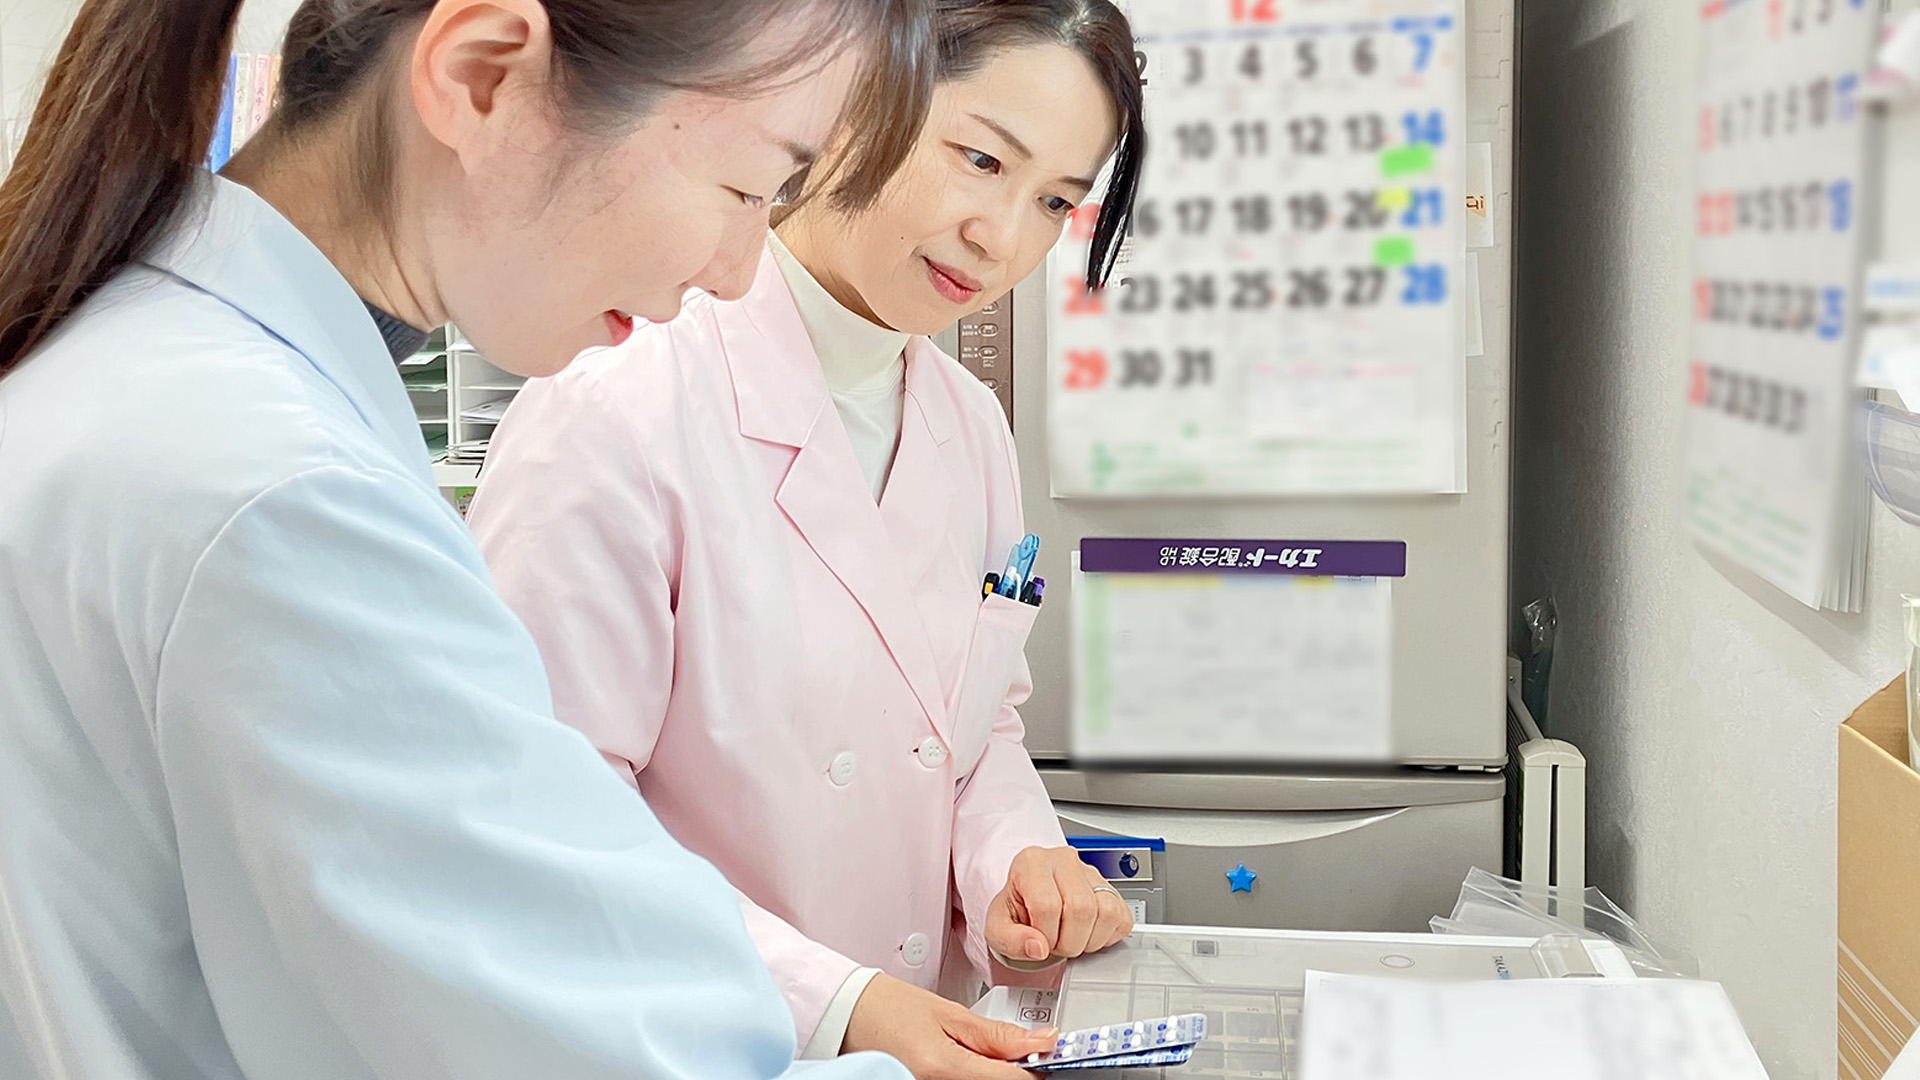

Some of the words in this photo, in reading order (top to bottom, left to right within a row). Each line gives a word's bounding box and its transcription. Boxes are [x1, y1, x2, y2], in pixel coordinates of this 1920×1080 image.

[1183, 47, 1204, 84] 3
[1238, 45, 1263, 79] 4
[1297, 41, 1319, 78] 5
[1353, 37, 1377, 75] 6
[1411, 34, 1433, 72] 7
[1174, 123, 1215, 160] 10
[1232, 120, 1268, 157] 11
[1288, 116, 1327, 154] 12
[1345, 114, 1384, 151] 13
[1402, 111, 1444, 147] 14
[1177, 201, 1212, 235] 17
[1231, 198, 1272, 234] 18
[1288, 196, 1328, 232] 19
[1402, 189, 1443, 228] 21
[1119, 276, 1160, 312] 23
[1172, 274, 1215, 312] 24
[1231, 271, 1272, 310] 25
[1287, 269, 1330, 309] 26
[1343, 267, 1387, 307] 27
[1401, 265, 1445, 305] 28
[1063, 350, 1108, 390] 29
[1119, 349, 1161, 388] 30
[1172, 350, 1213, 388] 31
